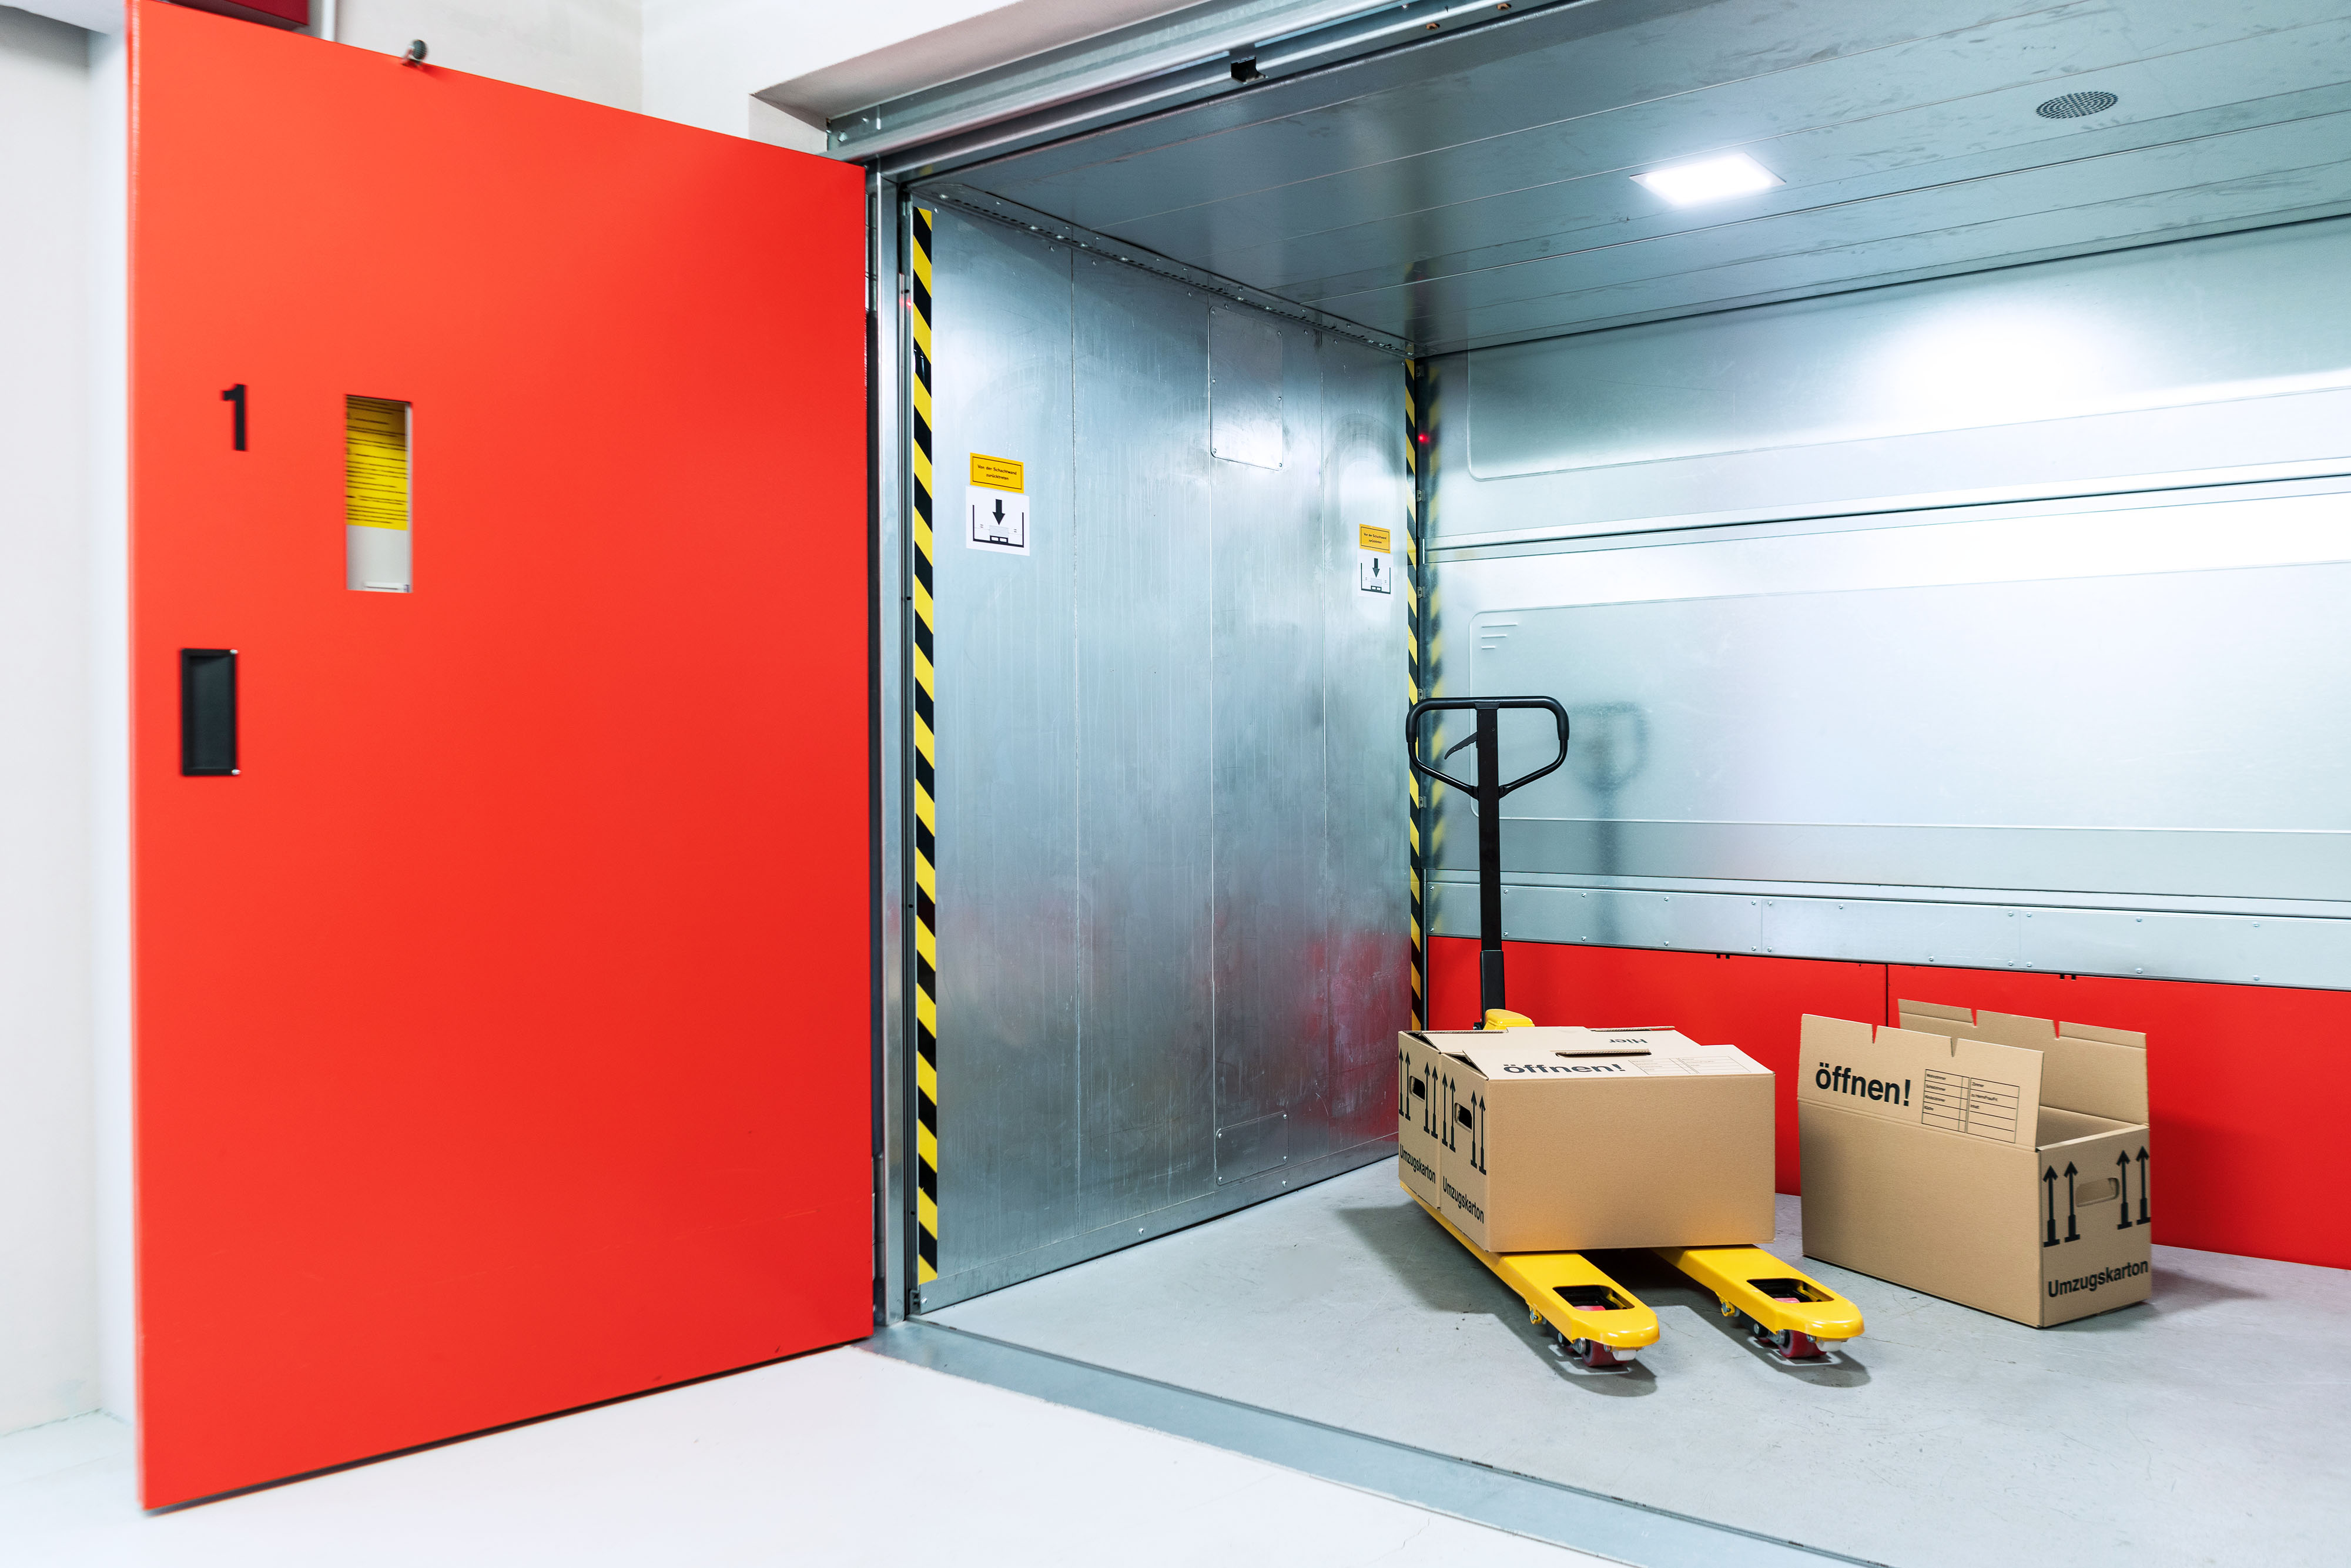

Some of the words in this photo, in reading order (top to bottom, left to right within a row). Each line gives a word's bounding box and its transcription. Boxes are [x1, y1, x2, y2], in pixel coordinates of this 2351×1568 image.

[222, 384, 246, 451] 1
[1503, 1064, 1626, 1074] öffnen!
[1816, 1062, 1911, 1107] öffnen!
[1400, 1143, 1436, 1184] Umzugskarton
[1443, 1175, 1484, 1224] Umzugskarton
[2048, 1261, 2148, 1297] Umzugskarton
